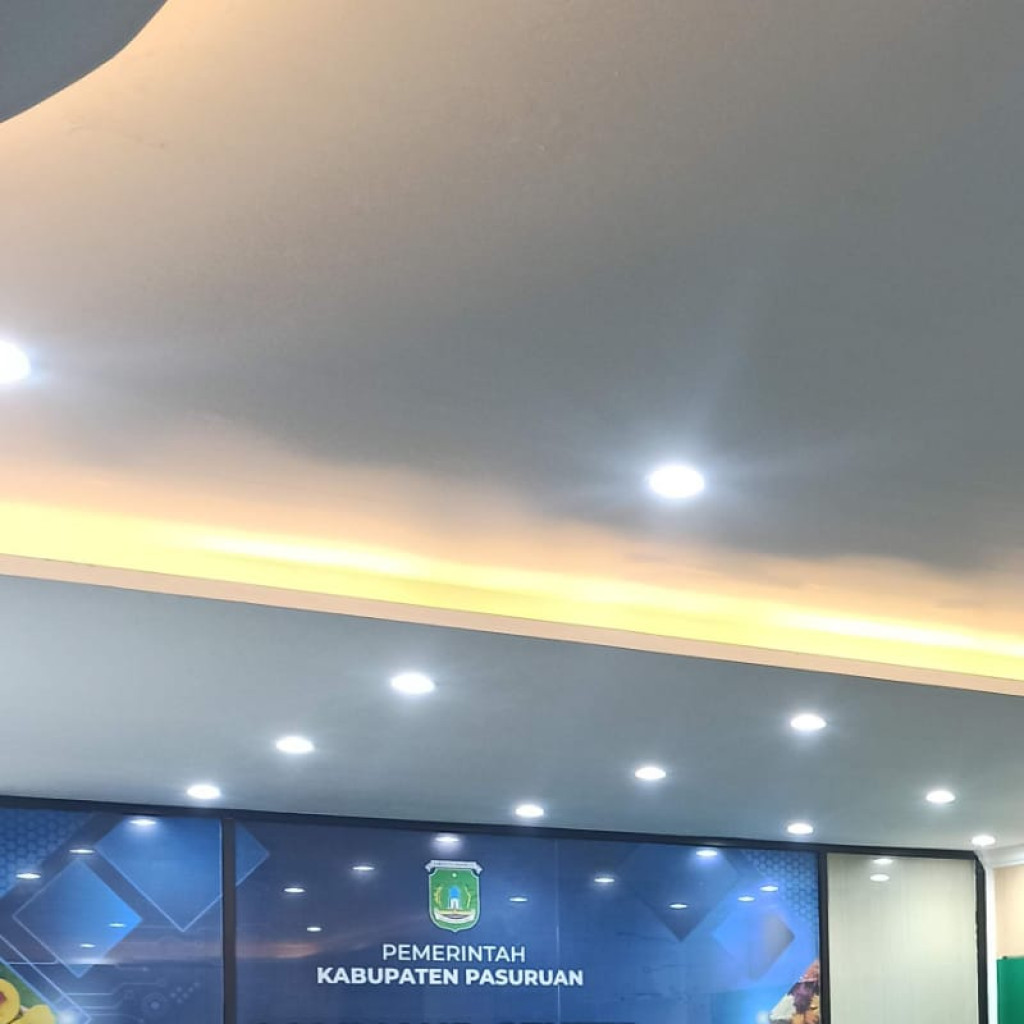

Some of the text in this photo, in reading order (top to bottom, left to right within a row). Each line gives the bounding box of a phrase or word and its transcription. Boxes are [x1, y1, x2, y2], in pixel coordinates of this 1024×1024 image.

[382, 943, 526, 963] PEMERINTAH
[317, 966, 584, 987] KABUPATEN PASURUAN
